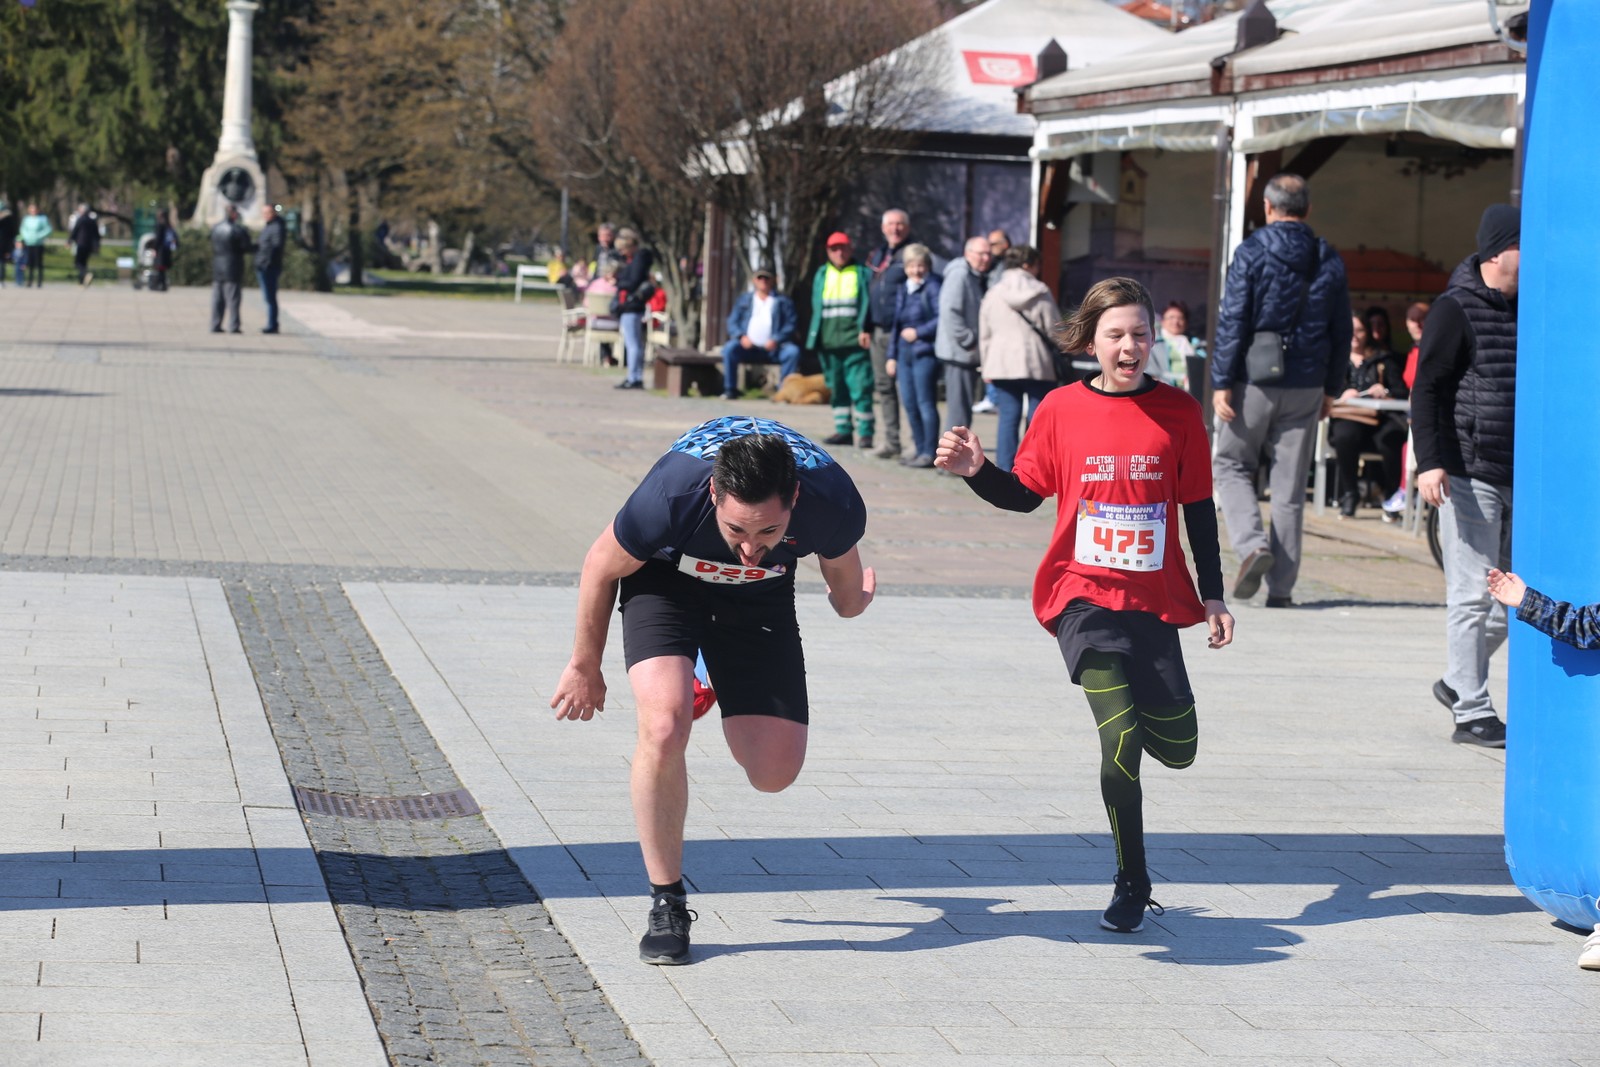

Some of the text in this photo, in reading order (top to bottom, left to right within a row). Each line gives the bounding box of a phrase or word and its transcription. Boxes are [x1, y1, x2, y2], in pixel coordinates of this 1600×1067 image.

[1086, 456, 1115, 466] ATLETSKI
[1130, 455, 1160, 464] ATHLETIC
[1098, 465, 1115, 473] KLUB
[1130, 464, 1147, 472] CLUB
[1093, 526, 1155, 555] 475
